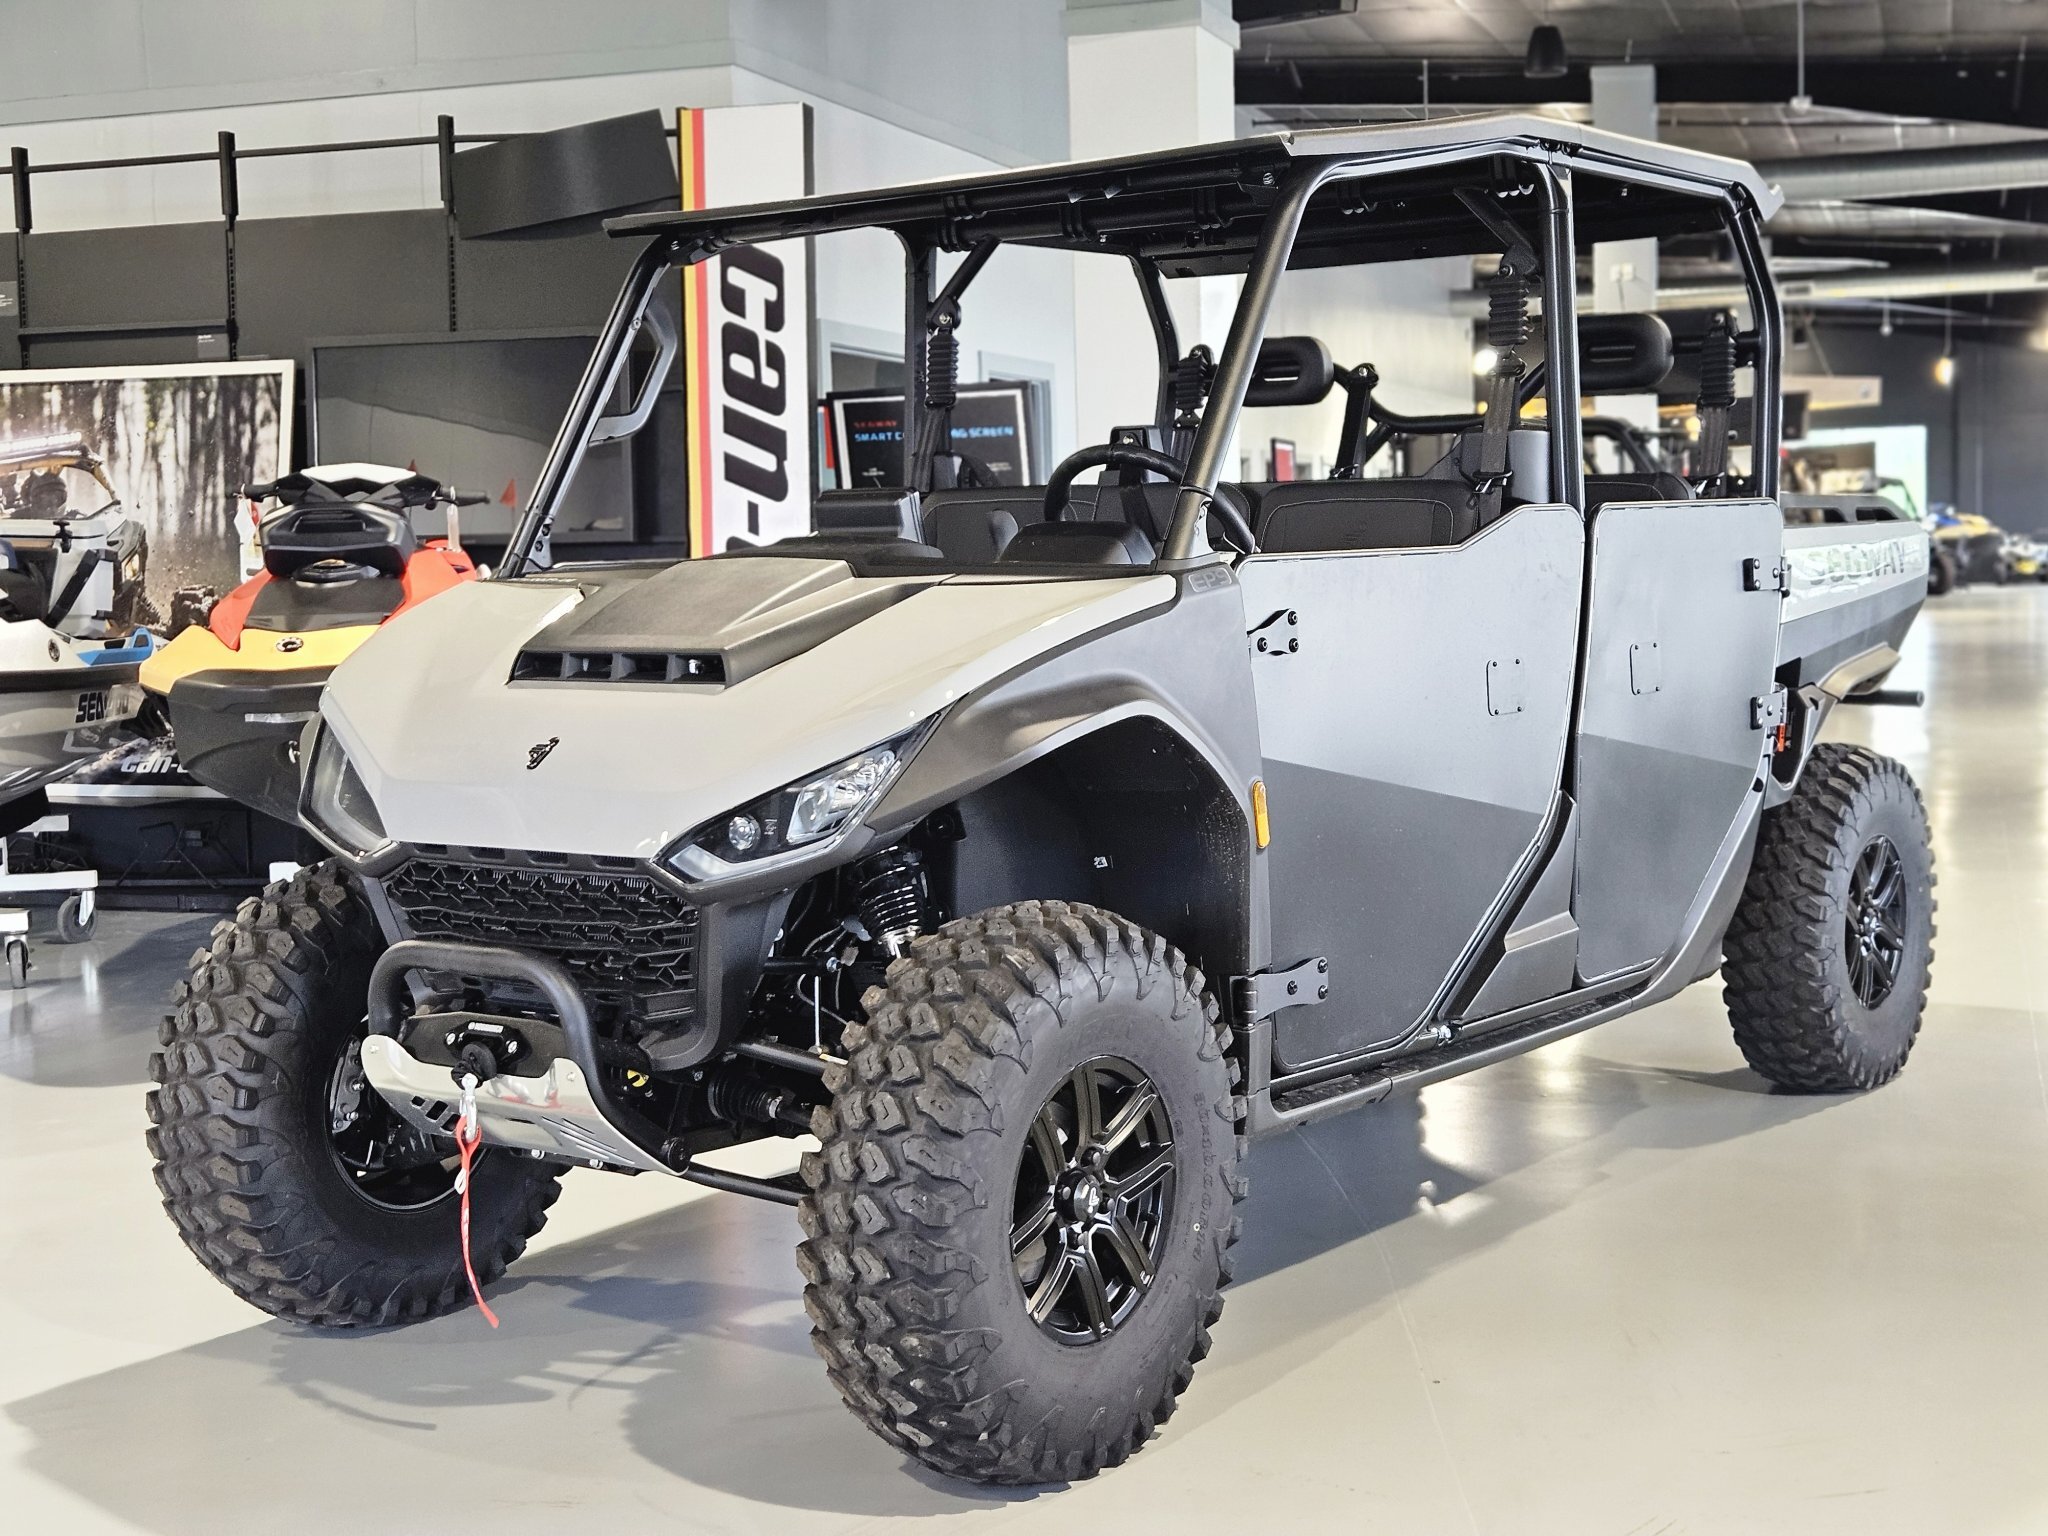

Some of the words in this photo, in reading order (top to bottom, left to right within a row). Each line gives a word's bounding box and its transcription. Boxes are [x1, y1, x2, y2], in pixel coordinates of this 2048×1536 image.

[720, 245, 788, 552] can-
[854, 432, 892, 442] SMART
[968, 426, 1014, 438] SCREEN
